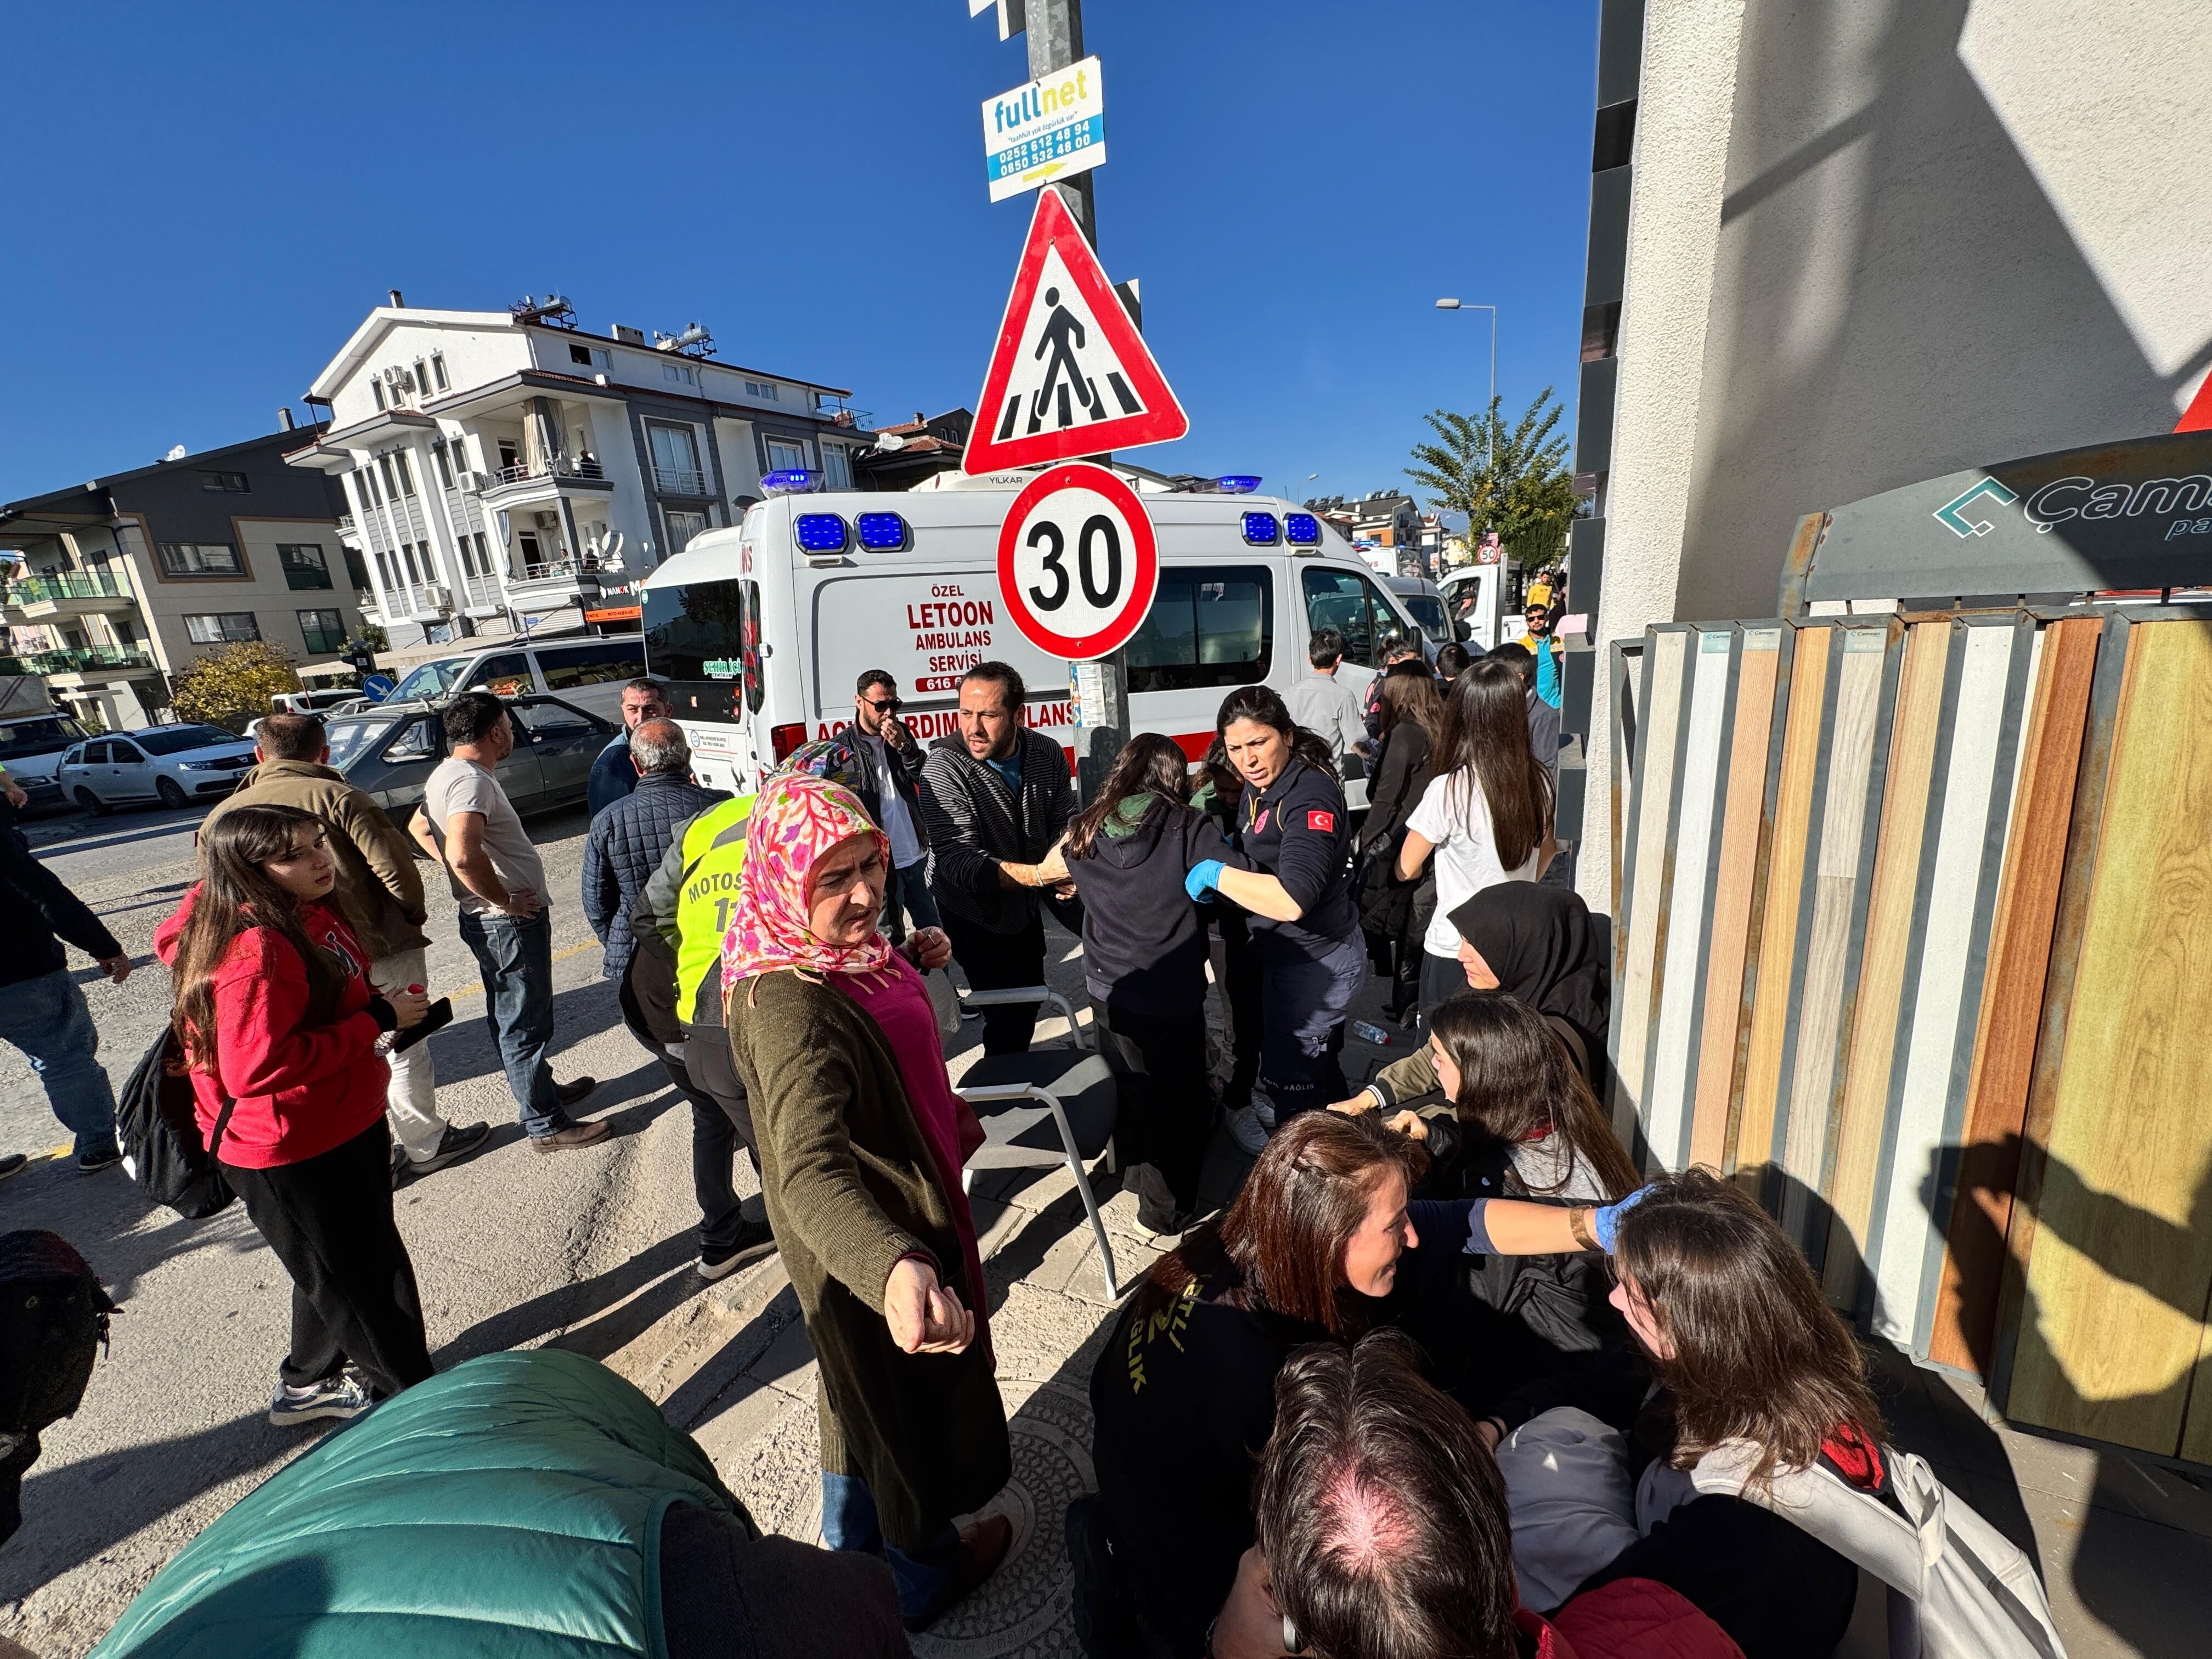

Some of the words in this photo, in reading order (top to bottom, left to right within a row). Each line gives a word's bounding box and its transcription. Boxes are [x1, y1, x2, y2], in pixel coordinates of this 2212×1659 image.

[995, 70, 1087, 133] fullnet
[1000, 144, 1027, 163] 0252
[1031, 135, 1052, 151] 612
[1056, 128, 1070, 142] 48
[1075, 121, 1090, 135] 94
[1032, 126, 1041, 136] yok
[1001, 157, 1028, 176] 0850
[1032, 148, 1053, 164] 532
[1057, 141, 1071, 154] 48
[1075, 134, 1090, 148] 00
[2024, 475, 2212, 534] Çam
[2164, 517, 2212, 541] pa
[1027, 514, 1122, 612] 30
[1482, 549, 1495, 560] 50
[932, 584, 964, 597] ÖZEL
[907, 601, 994, 629] LETOON
[916, 630, 991, 650] AMBULANS
[929, 649, 982, 672] SERVİSİ
[927, 678, 951, 690] 616
[898, 712, 959, 738] RDIM
[1027, 702, 1073, 729] LANS
[688, 872, 742, 904] MOTOS
